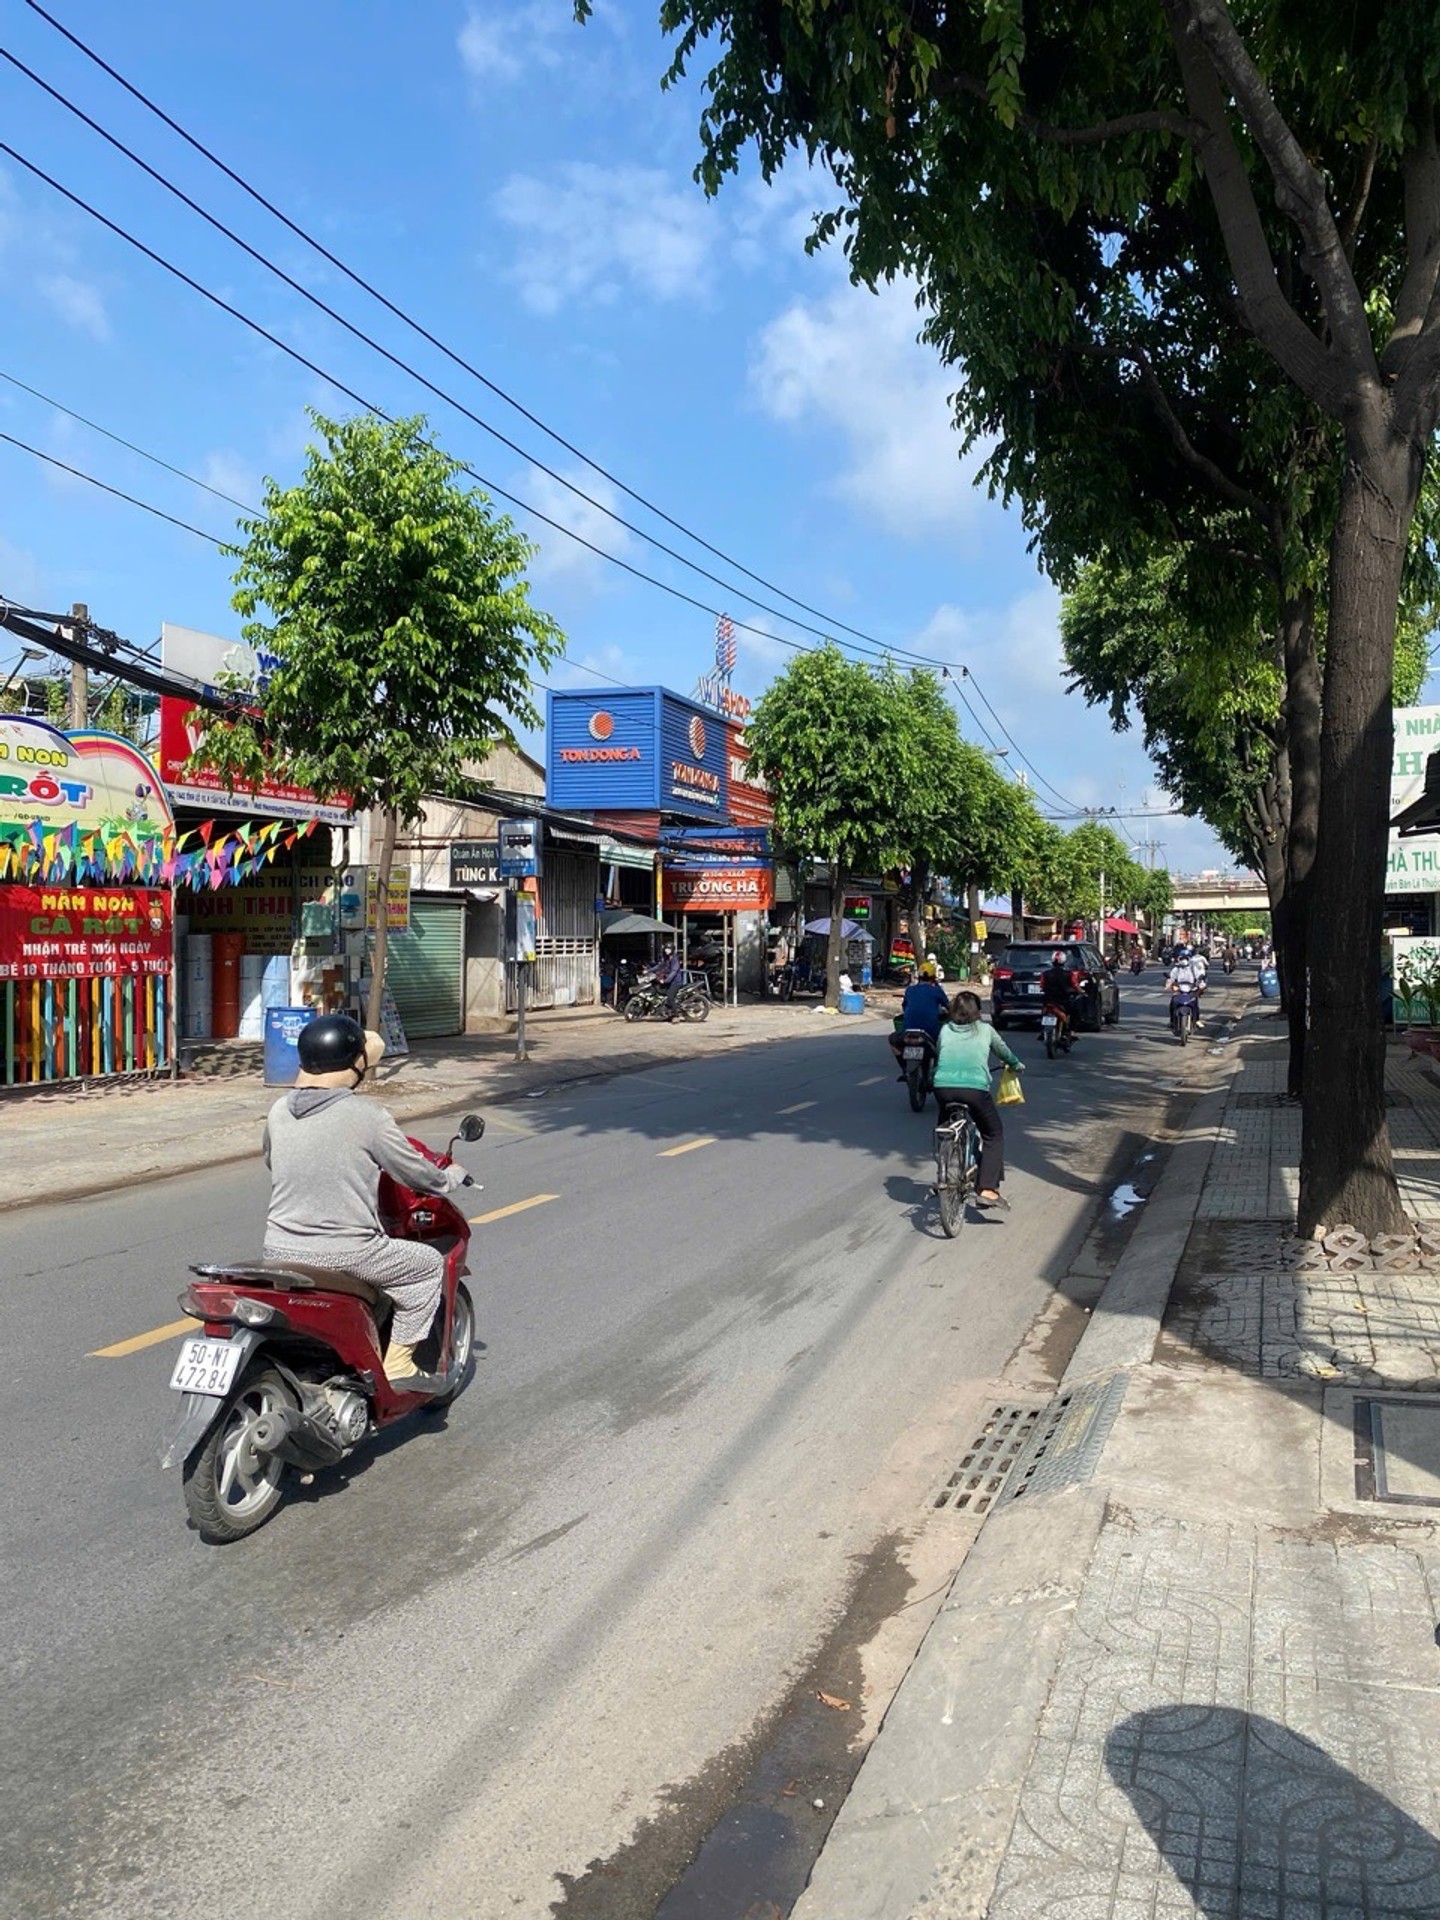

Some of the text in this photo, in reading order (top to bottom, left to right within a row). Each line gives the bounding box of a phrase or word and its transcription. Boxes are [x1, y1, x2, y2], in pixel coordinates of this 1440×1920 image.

[17, 745, 69, 768] NON
[1387, 847, 1408, 873] HÀ
[454, 864, 487, 882] TÙNG
[670, 875, 760, 894] TRƯỜNG HÀ
[93, 896, 135, 912] NON
[30, 911, 144, 935] CÀ RỐT
[22, 940, 60, 958] NHẬN
[64, 939, 87, 955] TRẺ
[120, 940, 152, 954] NGÀY
[42, 958, 85, 975] THÁNG
[174, 1365, 228, 1391] 472.84
